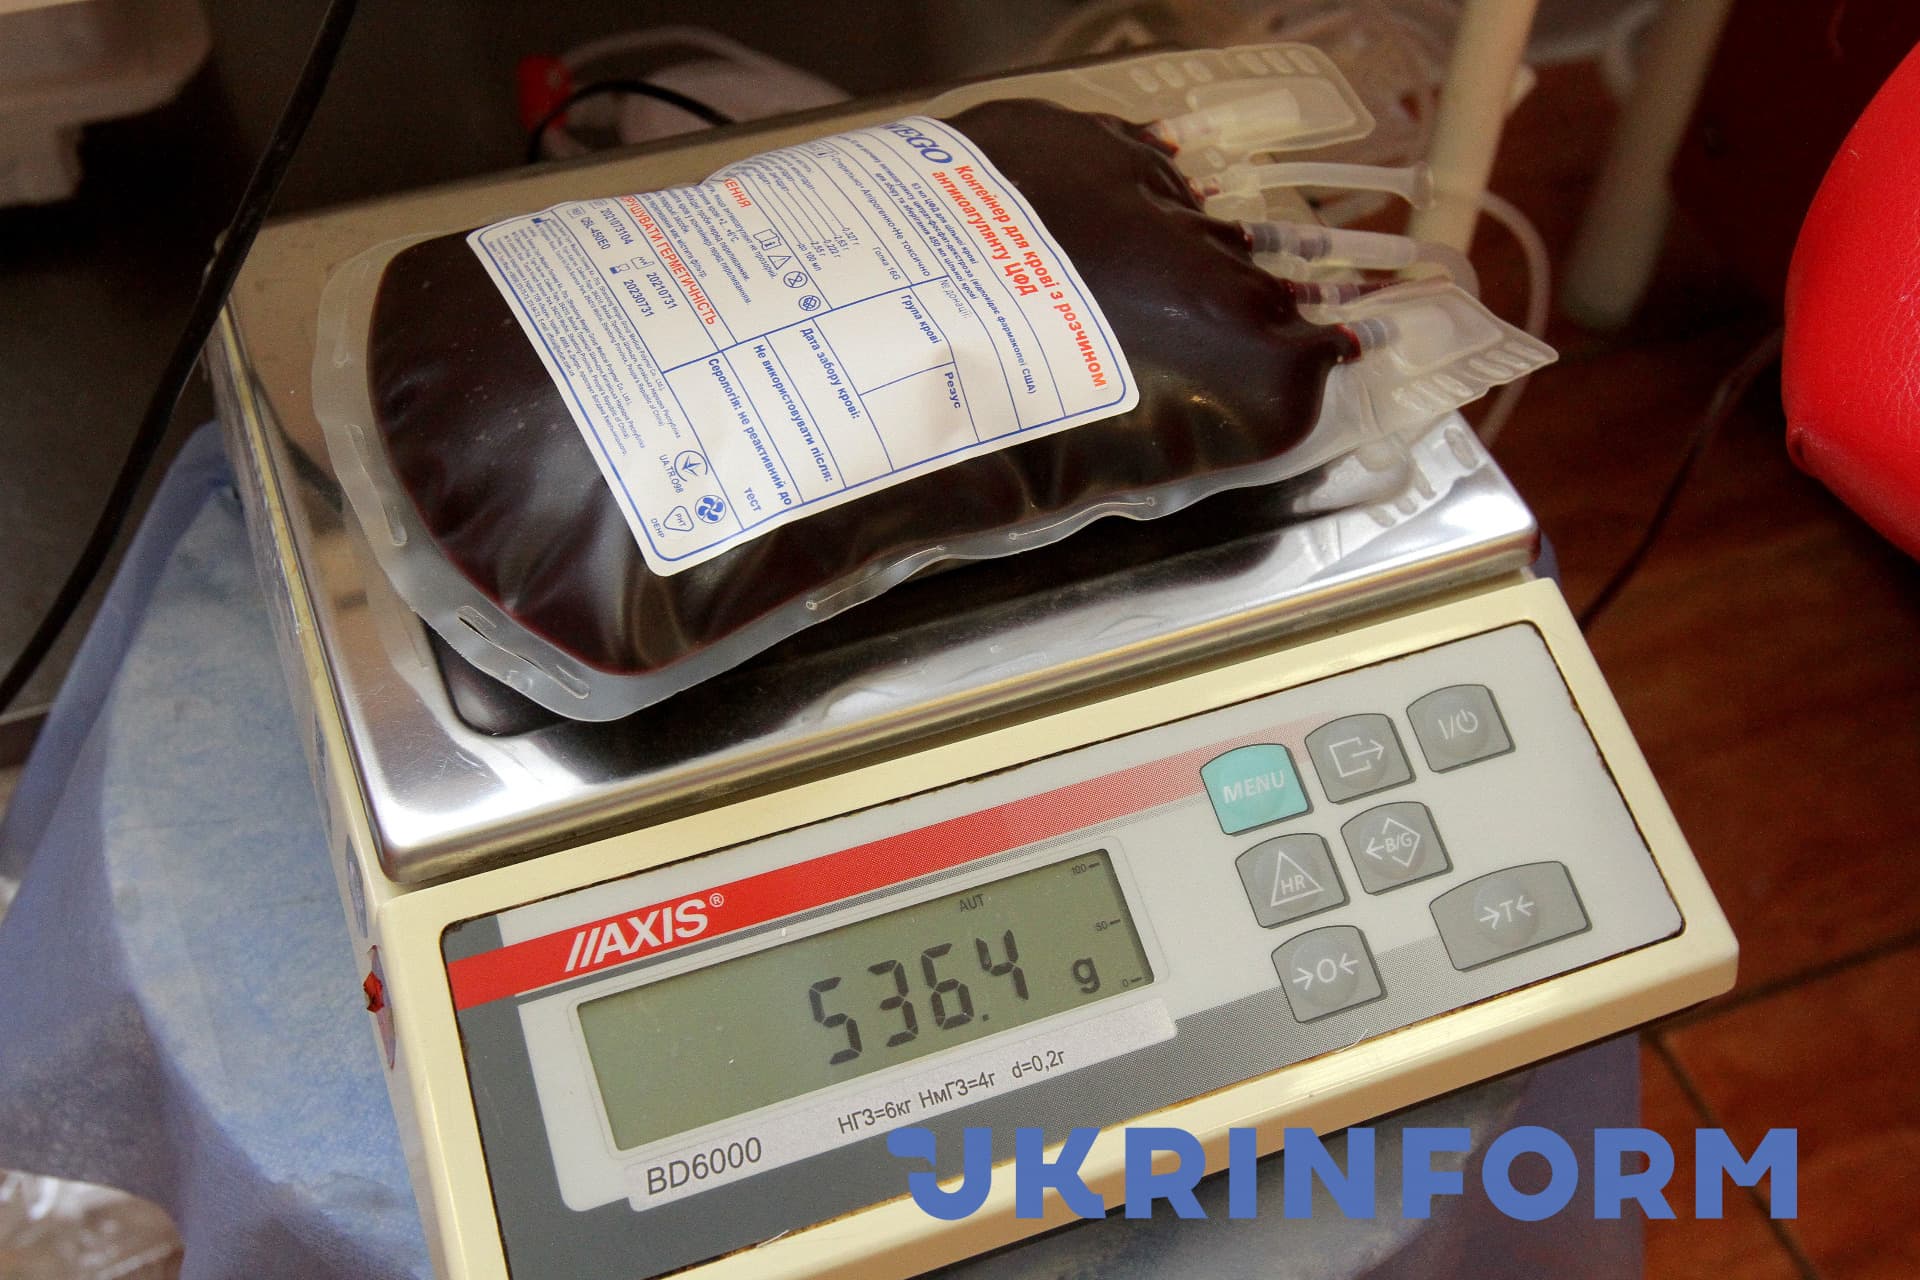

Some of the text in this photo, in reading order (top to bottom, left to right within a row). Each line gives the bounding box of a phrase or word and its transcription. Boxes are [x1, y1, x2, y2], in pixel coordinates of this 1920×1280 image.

[932, 171, 1039, 296] антикоагулянту ЦФД
[886, 266, 901, 280] 16G
[899, 239, 931, 277] токсично
[954, 165, 1107, 387] Контейнер для крові з розчином
[623, 279, 655, 317] 20230731
[646, 272, 678, 309] 20210731
[656, 243, 715, 325] ГЕРМЕТИЧНІСТЬ
[901, 295, 942, 343] Група крові
[800, 328, 861, 419] Дата забору крові:
[944, 372, 960, 408] Резус
[1020, 367, 1038, 395] США)
[708, 358, 792, 505] Серологія: не реактивний до
[753, 344, 832, 482] Не використовувати після:
[744, 488, 761, 511] тест
[1222, 770, 1285, 803] MENU
[1384, 833, 1413, 851] B/G
[959, 893, 985, 913] AUT
[1280, 874, 1306, 894] HR
[1095, 919, 1108, 932] 50
[808, 929, 1101, 1065] 536.4 g
[646, 1136, 763, 1196] BD6000
